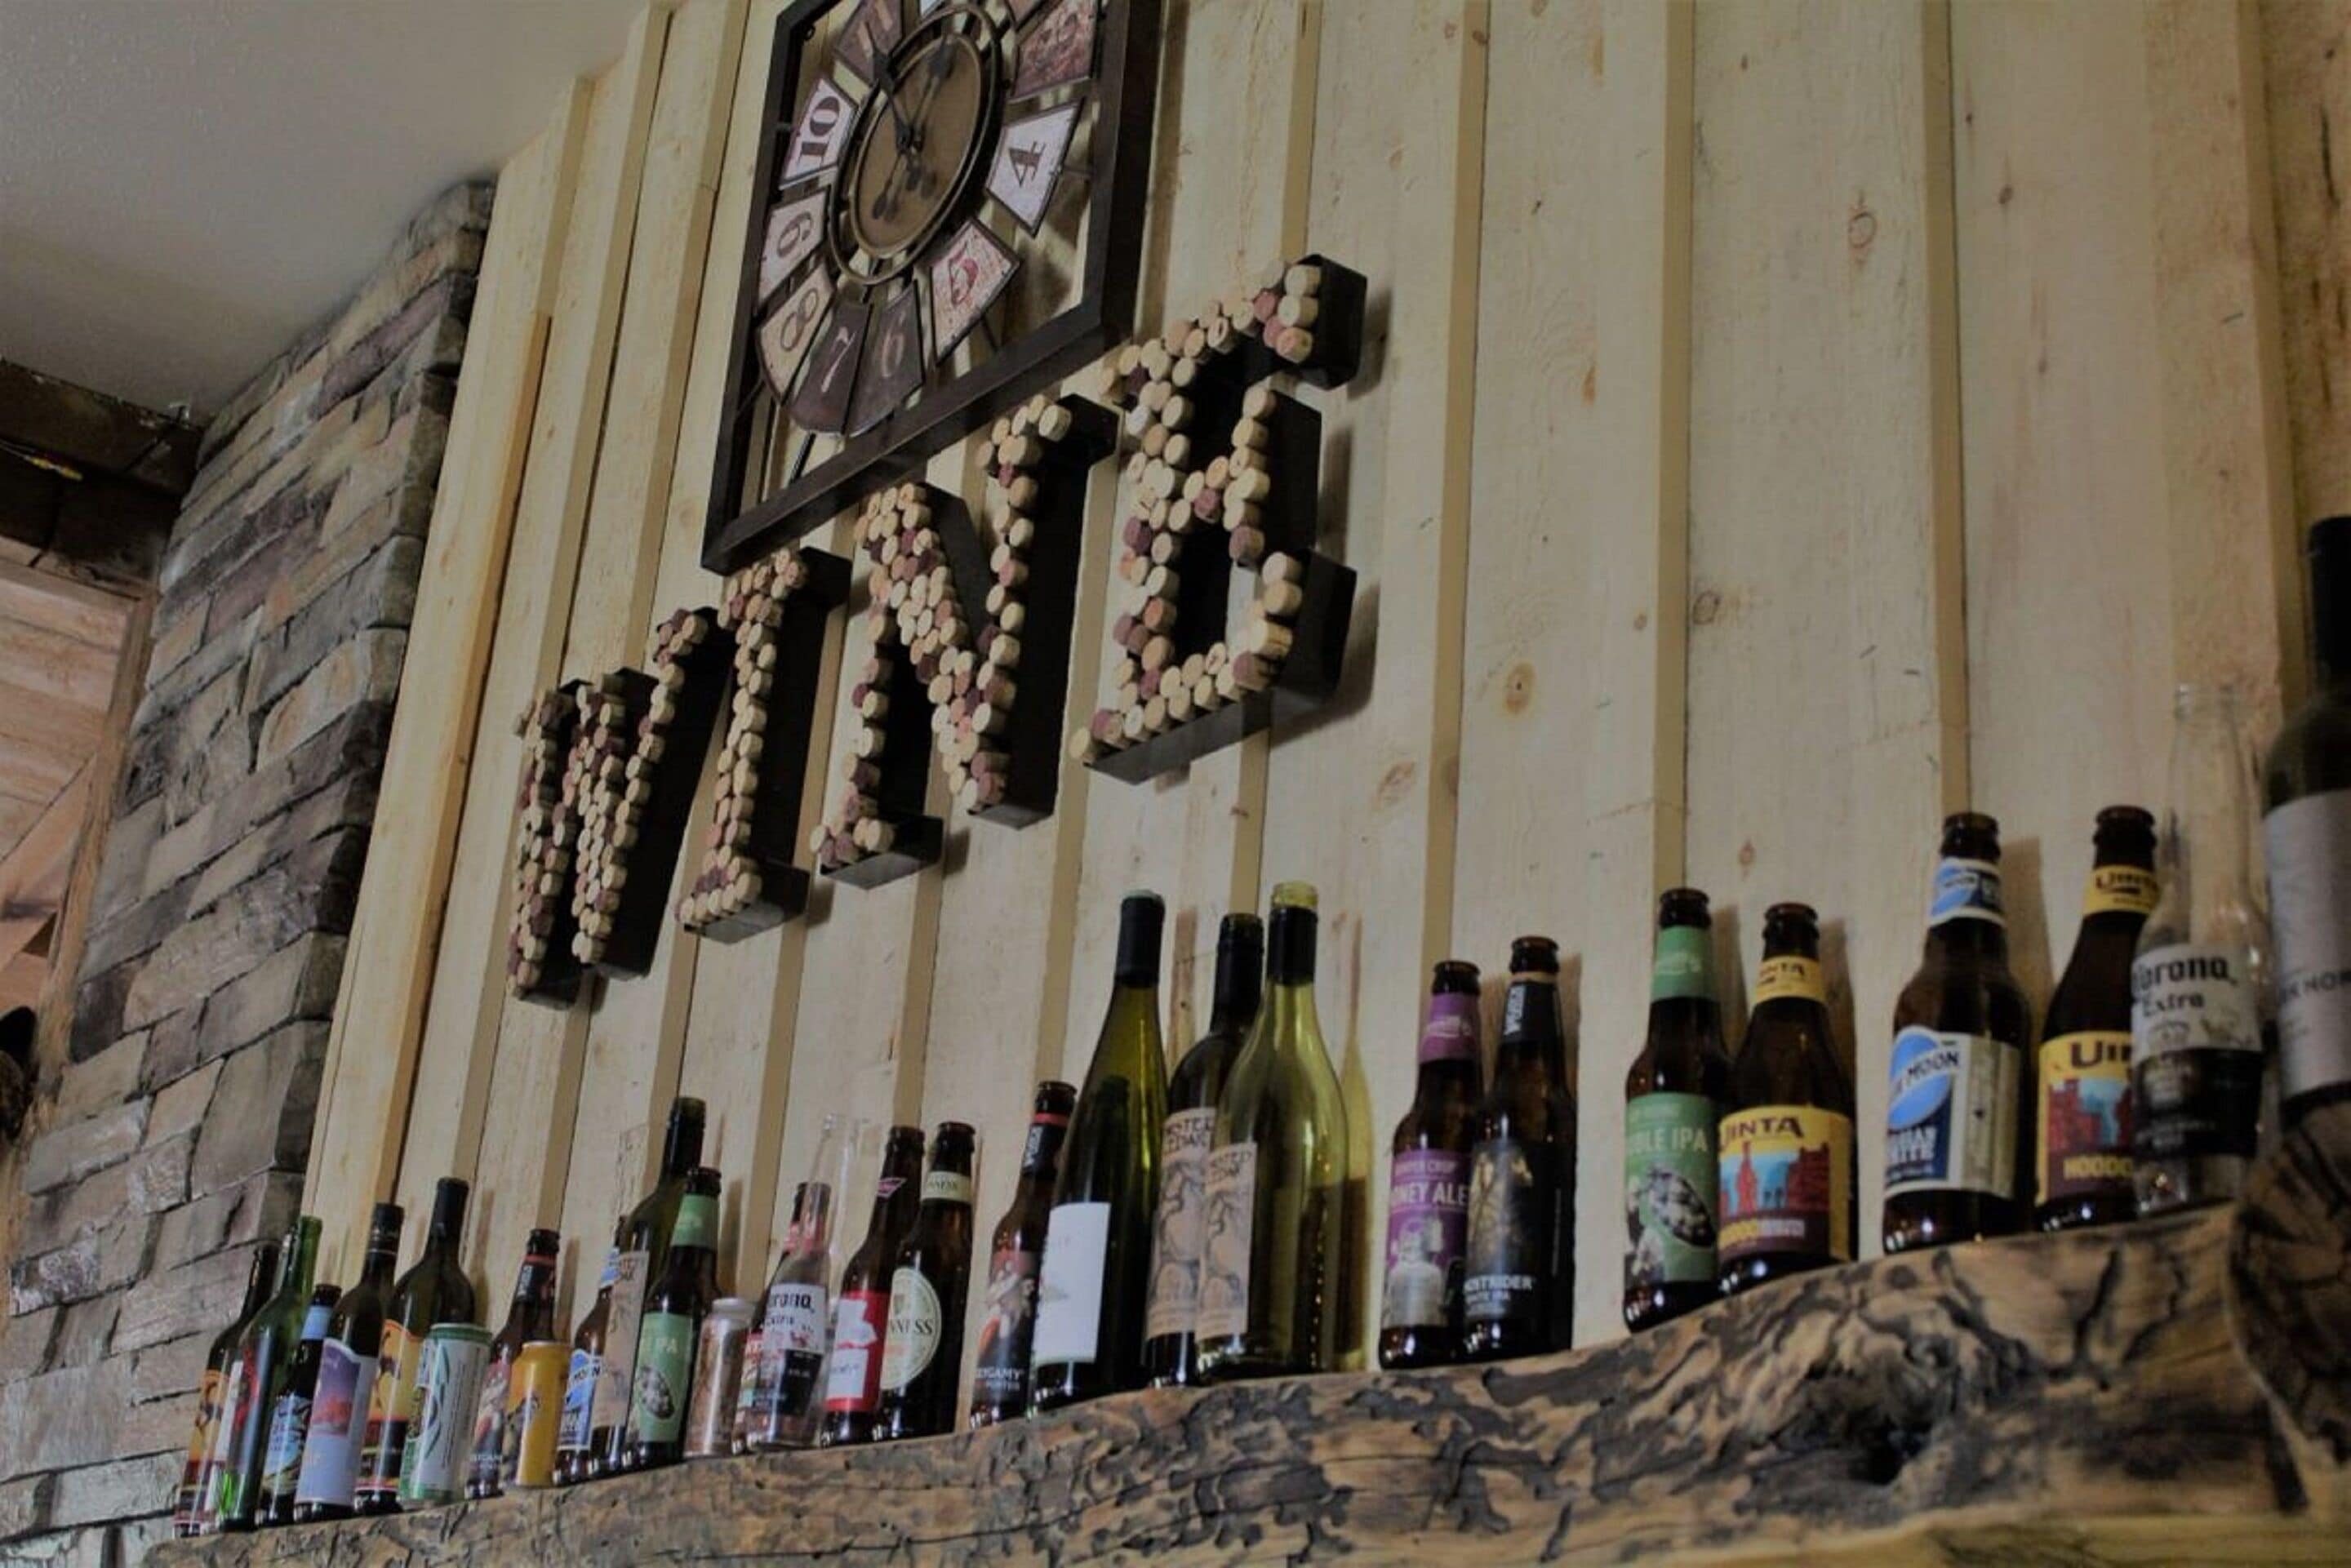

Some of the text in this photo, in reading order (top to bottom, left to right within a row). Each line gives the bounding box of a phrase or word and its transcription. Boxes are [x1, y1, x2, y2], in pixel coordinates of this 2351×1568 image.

[799, 96, 840, 165] 10
[1007, 141, 1046, 187] 4
[949, 239, 980, 305] 5
[780, 288, 817, 352] 8
[820, 326, 857, 393] 7
[508, 256, 1351, 1007] WINE
[1670, 1127, 1709, 1152] IPA
[1432, 1181, 1469, 1206] ALE
